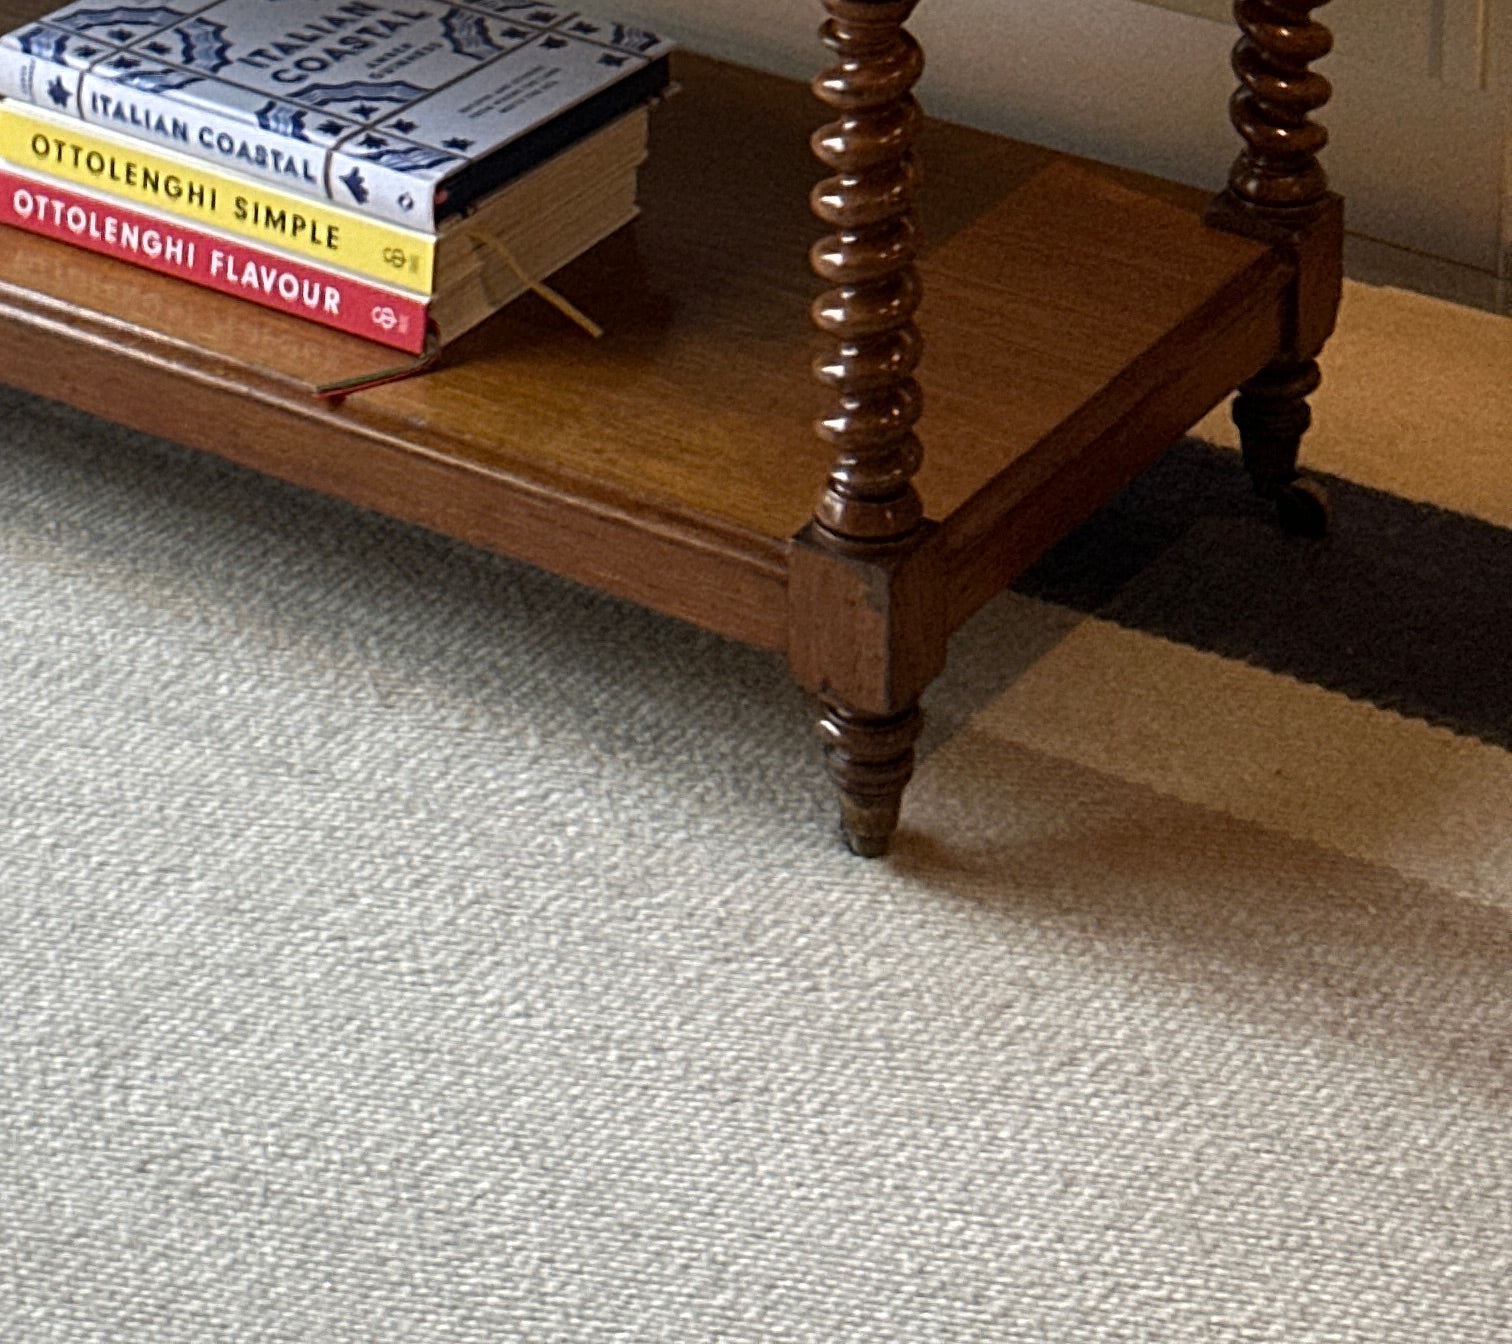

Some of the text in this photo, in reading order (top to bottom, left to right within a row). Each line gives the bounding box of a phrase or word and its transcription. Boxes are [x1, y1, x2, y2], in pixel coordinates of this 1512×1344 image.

[236, 0, 384, 69] ITALIAN
[270, 10, 433, 84] COASTAL
[91, 90, 318, 185] ITALIAN COASTAL
[31, 133, 340, 251] OTTOLENGHI SIMPLE
[13, 188, 341, 315] OTTOLENGHI FLAVOUR
